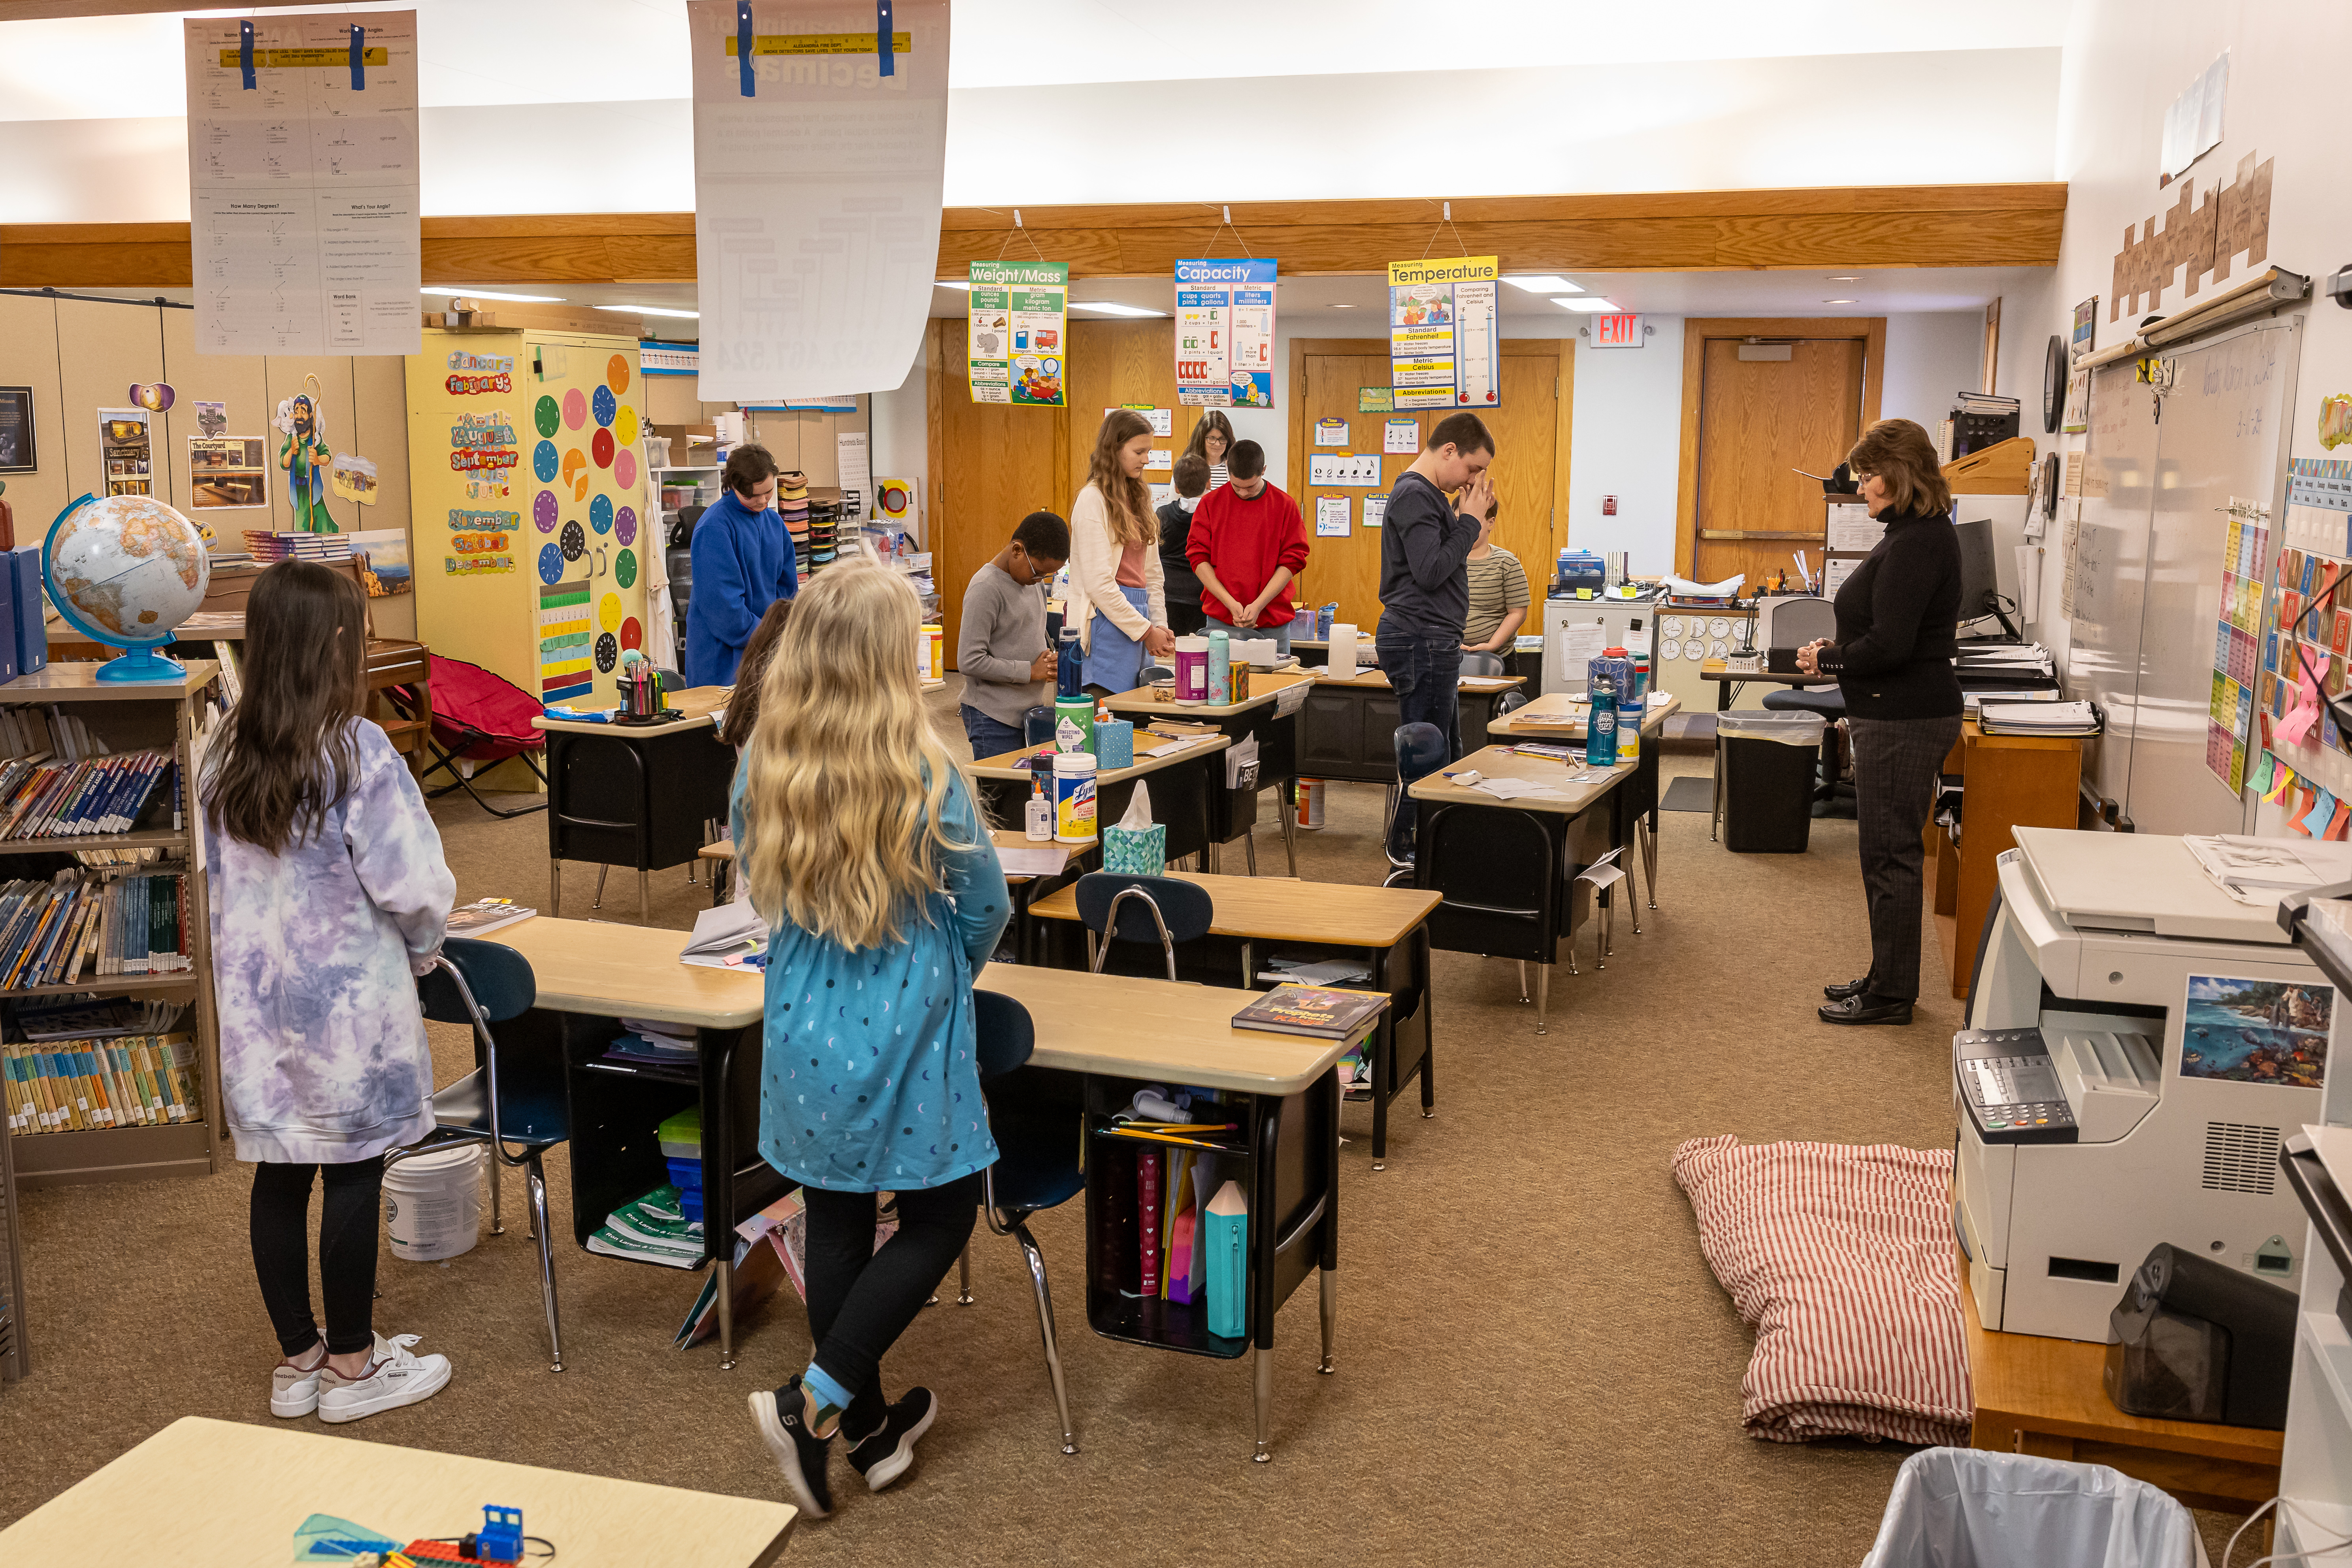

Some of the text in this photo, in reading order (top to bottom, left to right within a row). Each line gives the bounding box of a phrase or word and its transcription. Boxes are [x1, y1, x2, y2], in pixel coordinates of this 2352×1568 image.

[971, 268, 1061, 284] Weight/Mass
[1178, 266, 1251, 282] Capacity
[1392, 265, 1493, 283] Temperature
[1600, 315, 1636, 343] EXIT
[450, 352, 511, 371] January
[450, 377, 504, 393] February
[456, 427, 511, 445] August
[109, 448, 140, 458] Sanctuary
[202, 442, 225, 450] Courtyard
[452, 452, 516, 469] September
[908, 491, 913, 504] 1
[451, 511, 518, 526] November
[454, 535, 506, 551] October
[445, 557, 511, 572] December
[87, 771, 104, 795] BETSY ROSS
[108, 769, 124, 793] HENRY FORD
[1075, 780, 1096, 800] Lysol
[462, 904, 530, 913] BETH
[81, 927, 92, 947] NEIGHBORS
[59, 948, 69, 965] CHILDREN
[1269, 1008, 1335, 1019] Prophets
[1272, 1015, 1325, 1025] Kings
[626, 1213, 638, 1222] Ron
[639, 1221, 660, 1233] Larson
[606, 1233, 618, 1241] Ron
[619, 1239, 641, 1248] Larson
